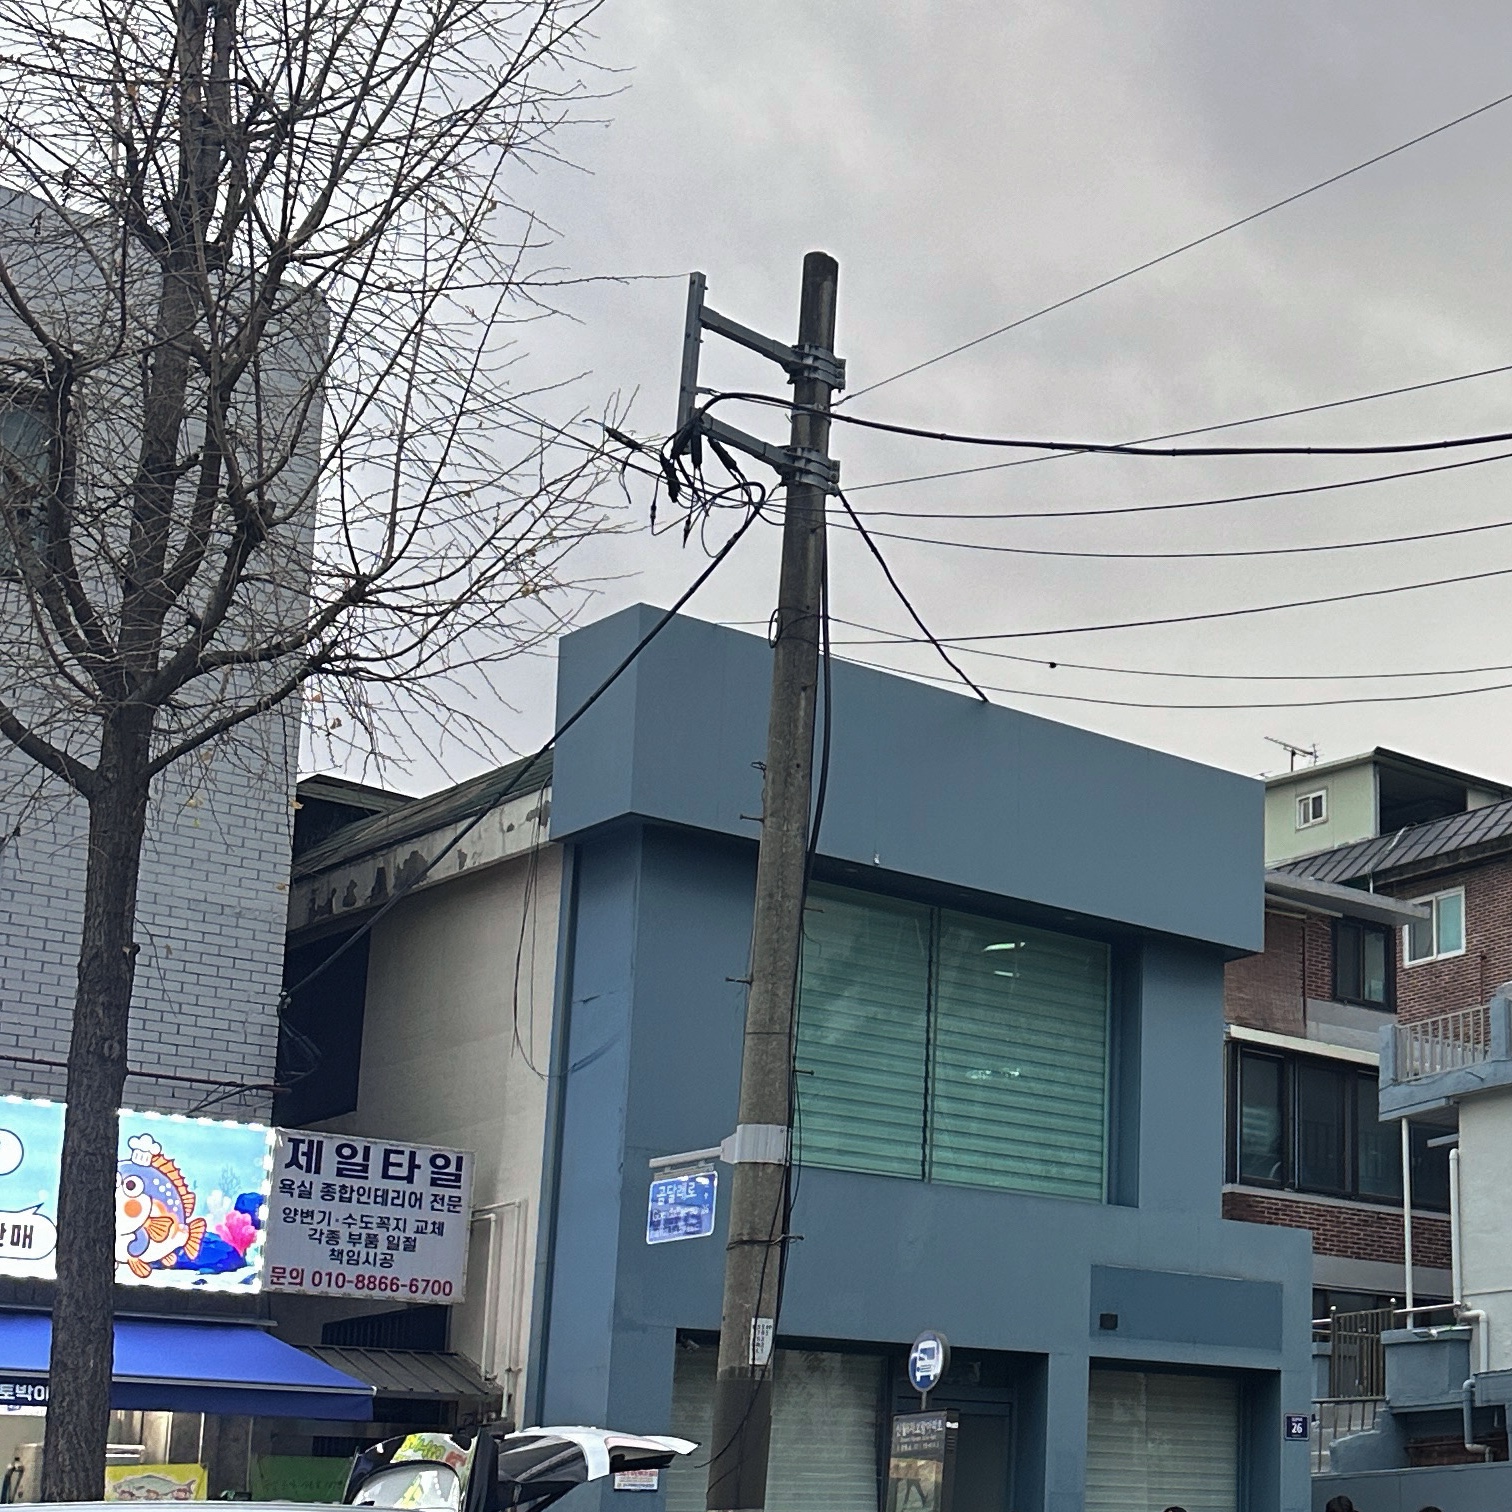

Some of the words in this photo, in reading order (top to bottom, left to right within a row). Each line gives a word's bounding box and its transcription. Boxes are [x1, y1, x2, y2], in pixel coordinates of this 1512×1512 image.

[284, 1137, 464, 1190] 제일타일
[278, 1178, 314, 1200] 욕실
[320, 1181, 424, 1210] 종합인테리어
[430, 1193, 463, 1214] 전문
[307, 1227, 341, 1246] 각종
[347, 1231, 379, 1250] 부품
[386, 1234, 417, 1253] 일절
[414, 1218, 445, 1237] 교체
[329, 1247, 395, 1269] 책임시공
[270, 1265, 305, 1287] 문의
[311, 1270, 453, 1297] 010-8866-6700
[1291, 1422, 1303, 1434] 26
